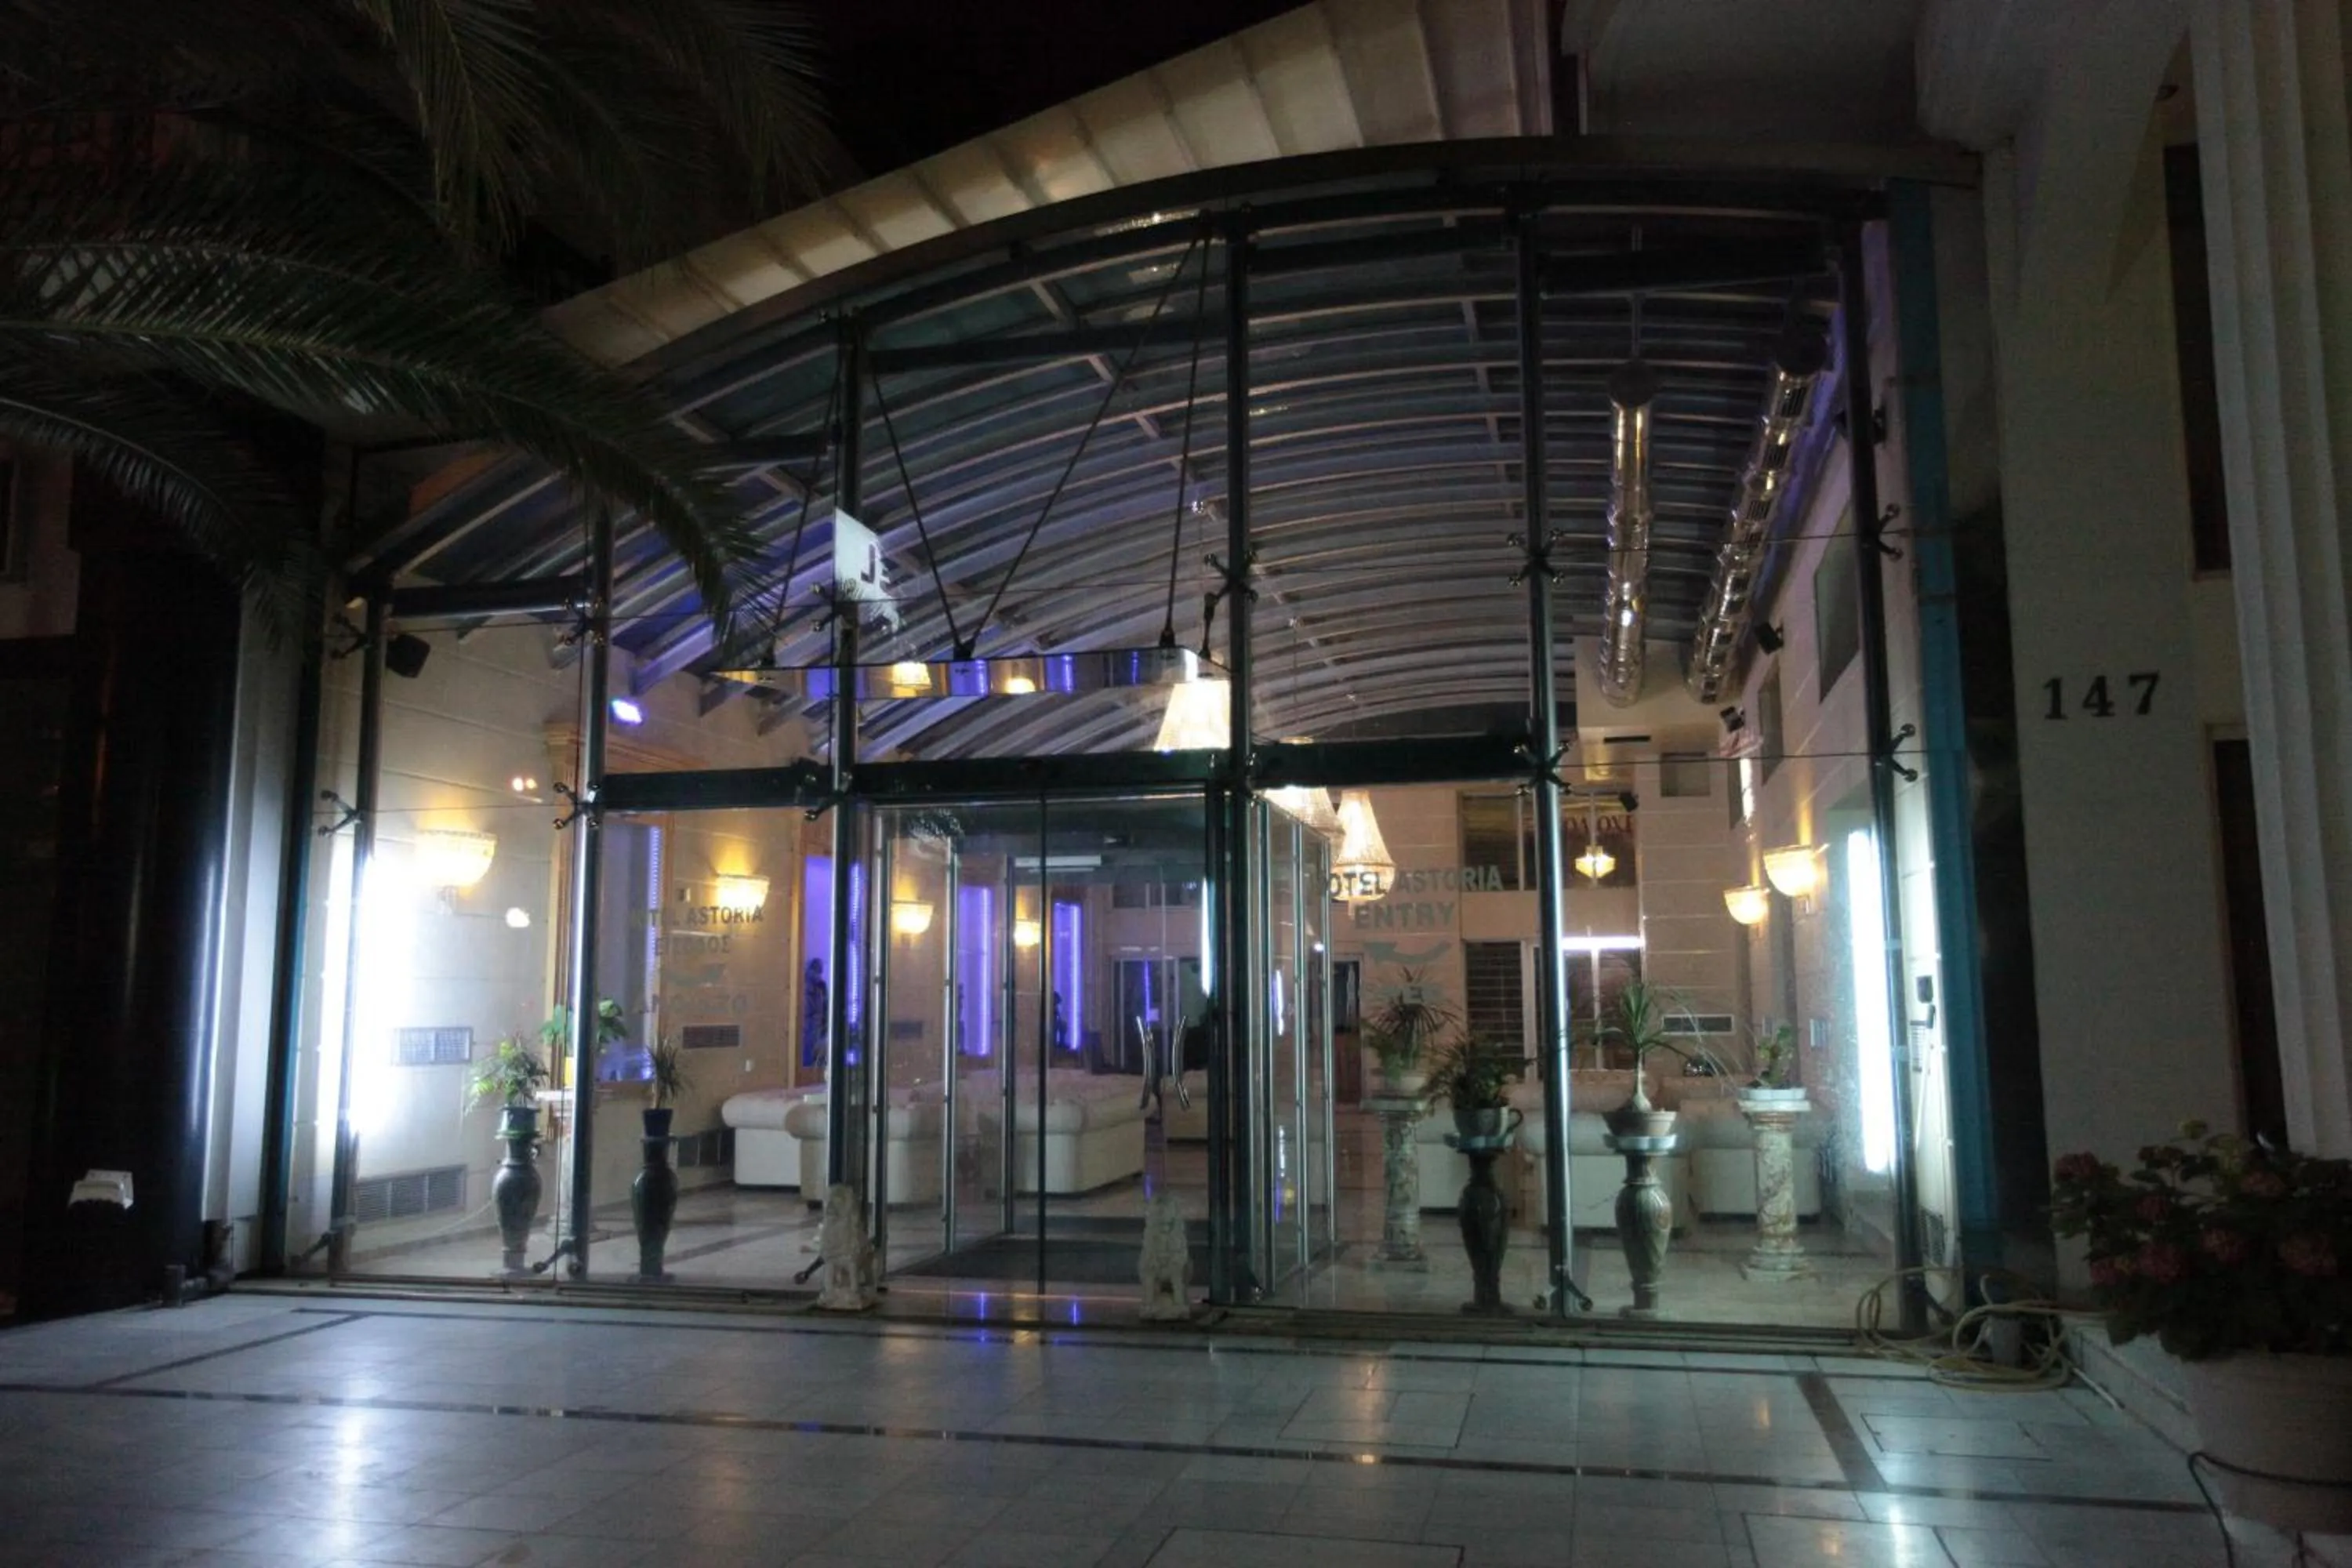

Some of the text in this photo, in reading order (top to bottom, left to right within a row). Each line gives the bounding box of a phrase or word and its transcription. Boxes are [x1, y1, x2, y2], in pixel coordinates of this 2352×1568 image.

[2042, 671, 2161, 720] 147
[1319, 865, 1504, 897] OTEL ASTORIA
[687, 904, 764, 927] ASTORIA
[1354, 902, 1456, 930] ENTRY
